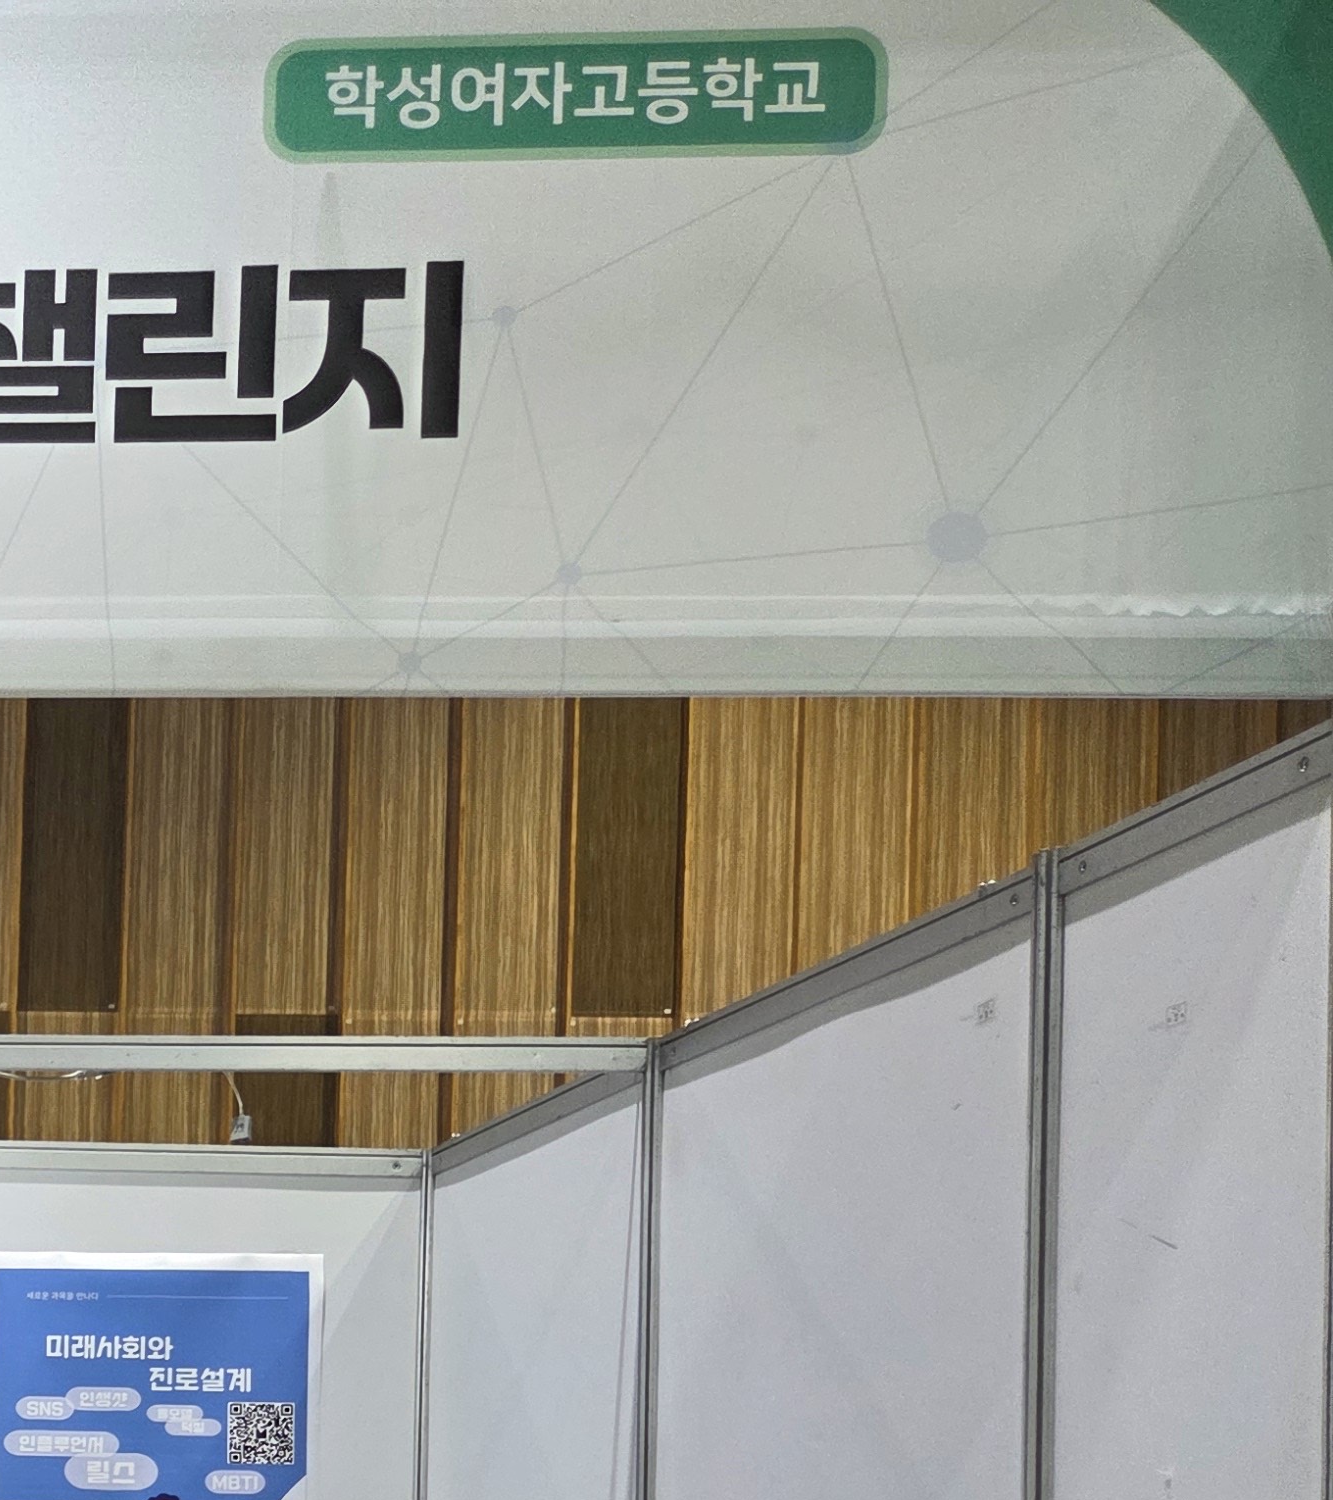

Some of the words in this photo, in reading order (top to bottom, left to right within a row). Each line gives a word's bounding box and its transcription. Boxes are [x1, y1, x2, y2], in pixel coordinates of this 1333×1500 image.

[325, 58, 826, 128] 학성여자고등학교
[45, 1335, 174, 1361] 미래사회와
[149, 1367, 253, 1393] 진로설계
[26, 1400, 64, 1416] SNS
[79, 1392, 128, 1409] 인생샷
[19, 1435, 105, 1455] 인플루언서
[86, 1460, 136, 1485] 릴스
[211, 1474, 259, 1490] MBTI
